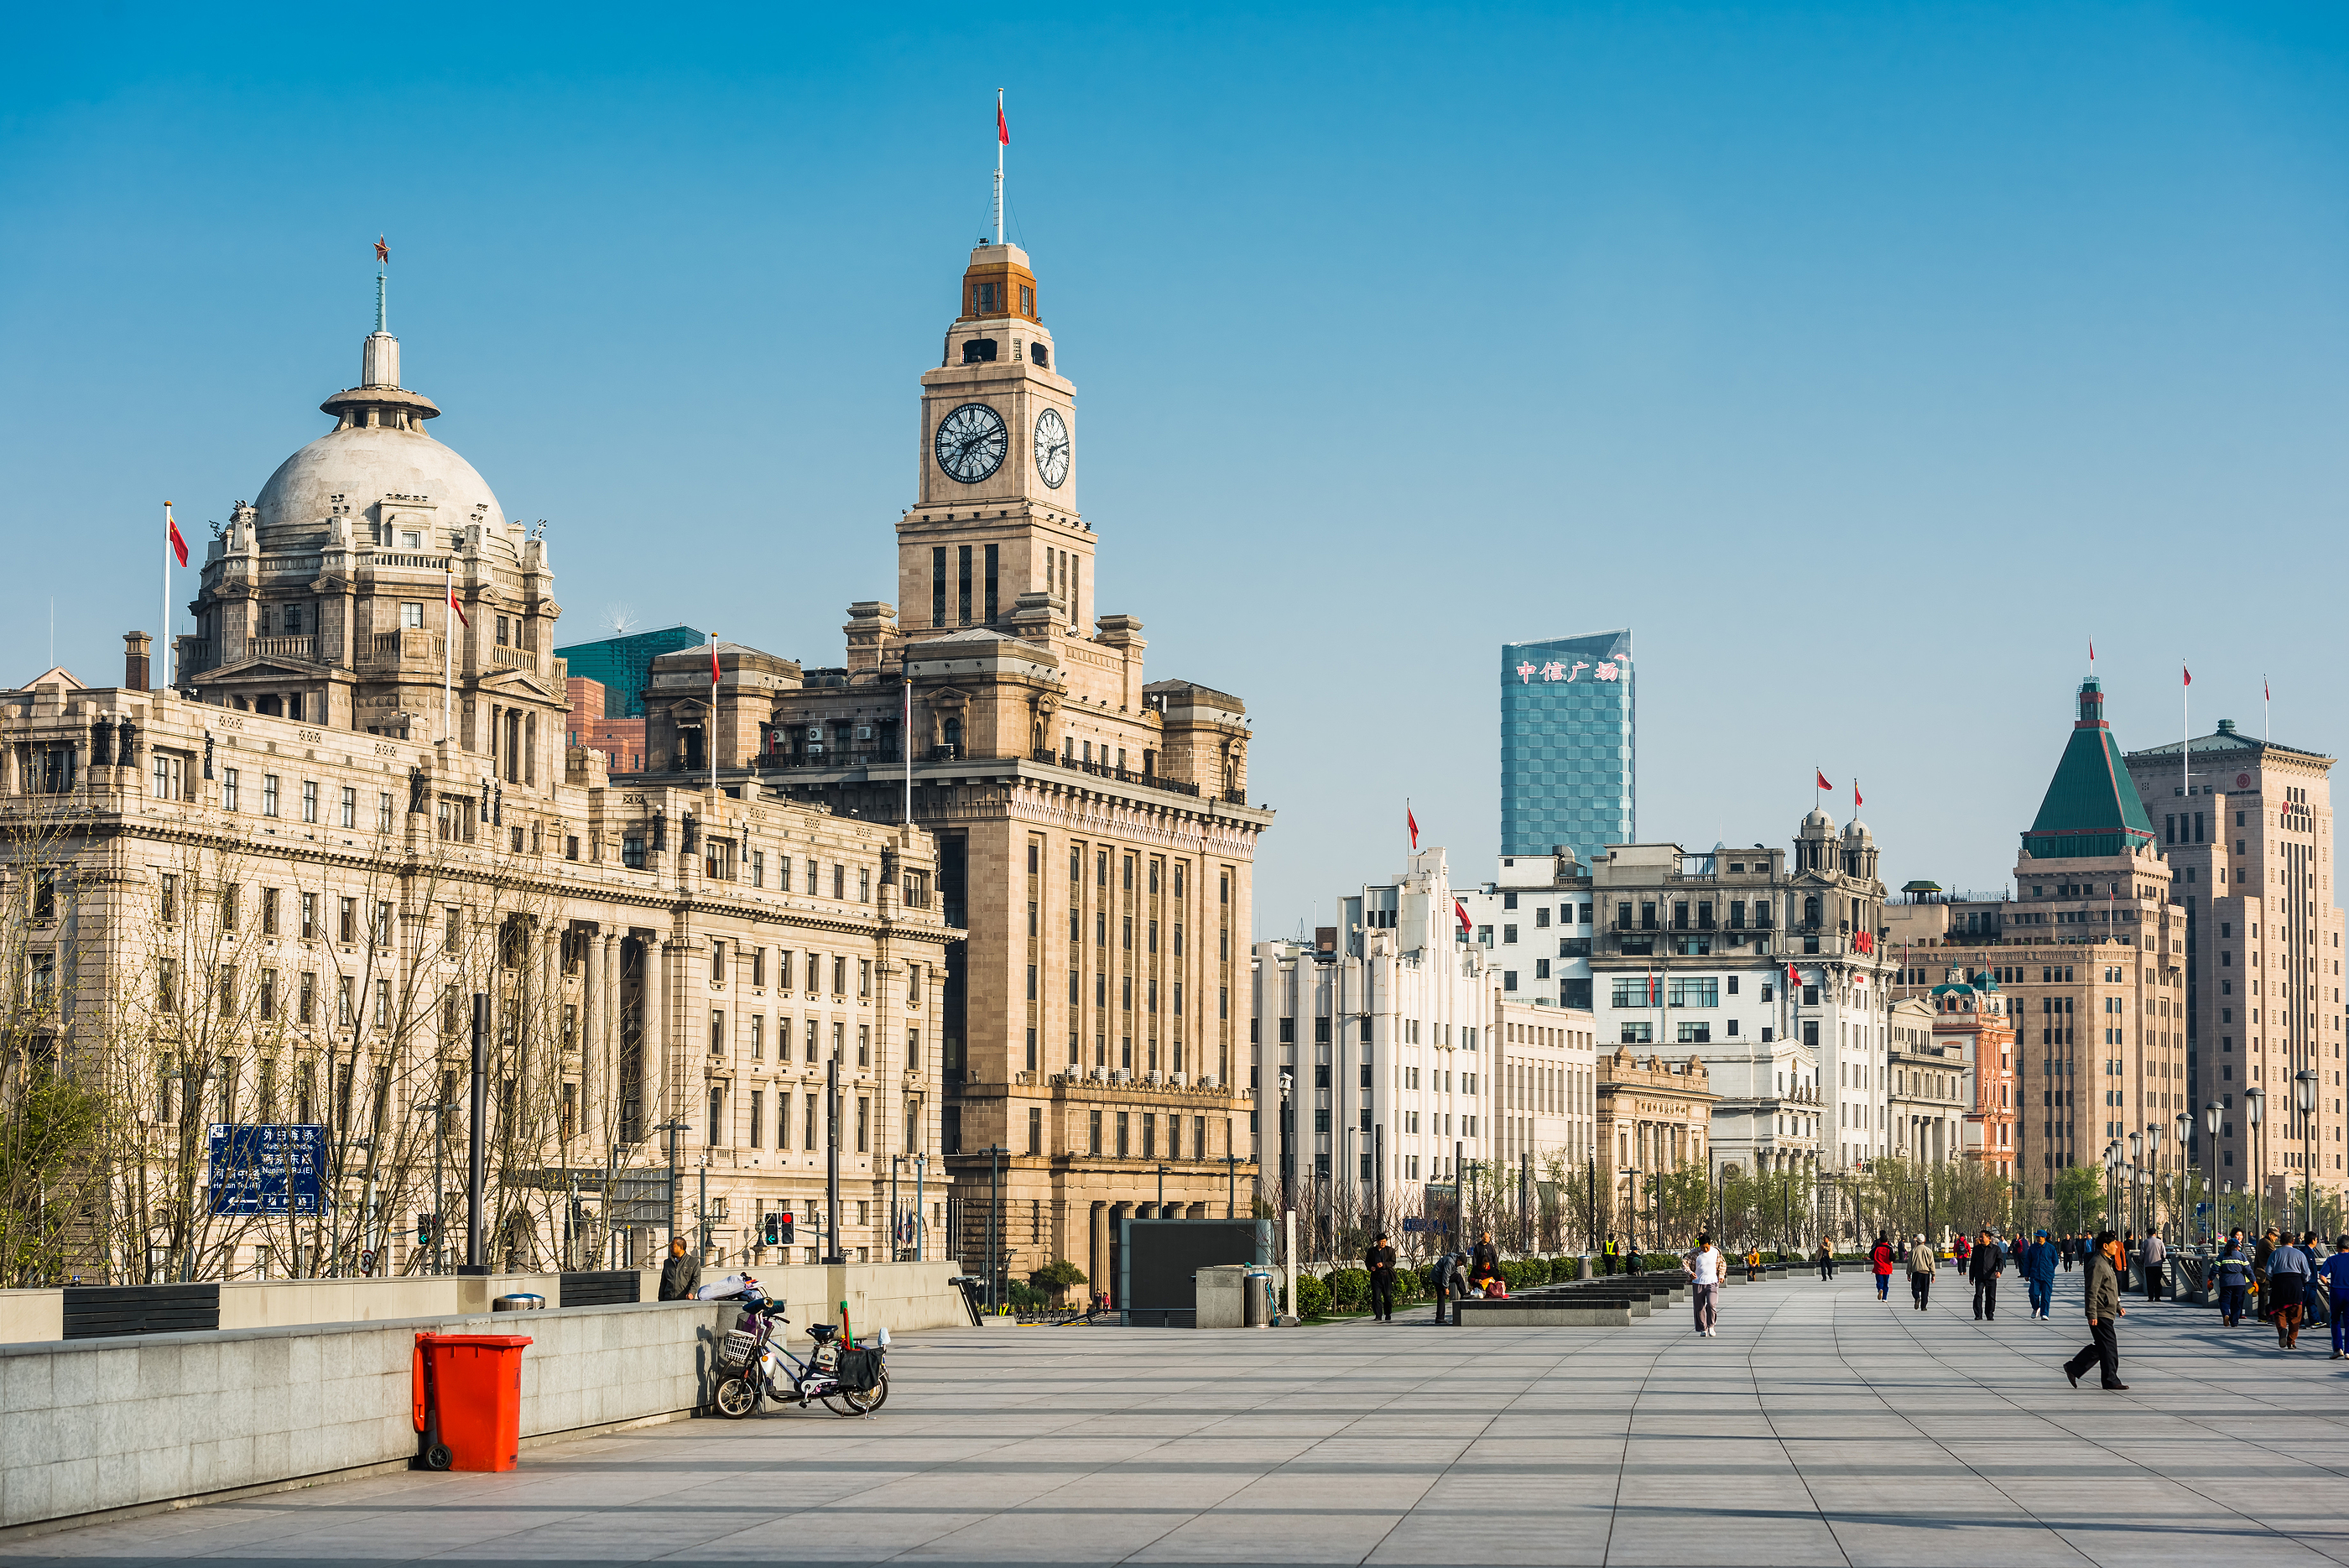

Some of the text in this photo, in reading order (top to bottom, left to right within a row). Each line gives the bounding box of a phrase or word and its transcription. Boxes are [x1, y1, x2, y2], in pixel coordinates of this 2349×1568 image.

[1516, 661, 1619, 684] 中信广场
[1855, 930, 1873, 954] AIA
[263, 1167, 287, 1175] Nanjin
